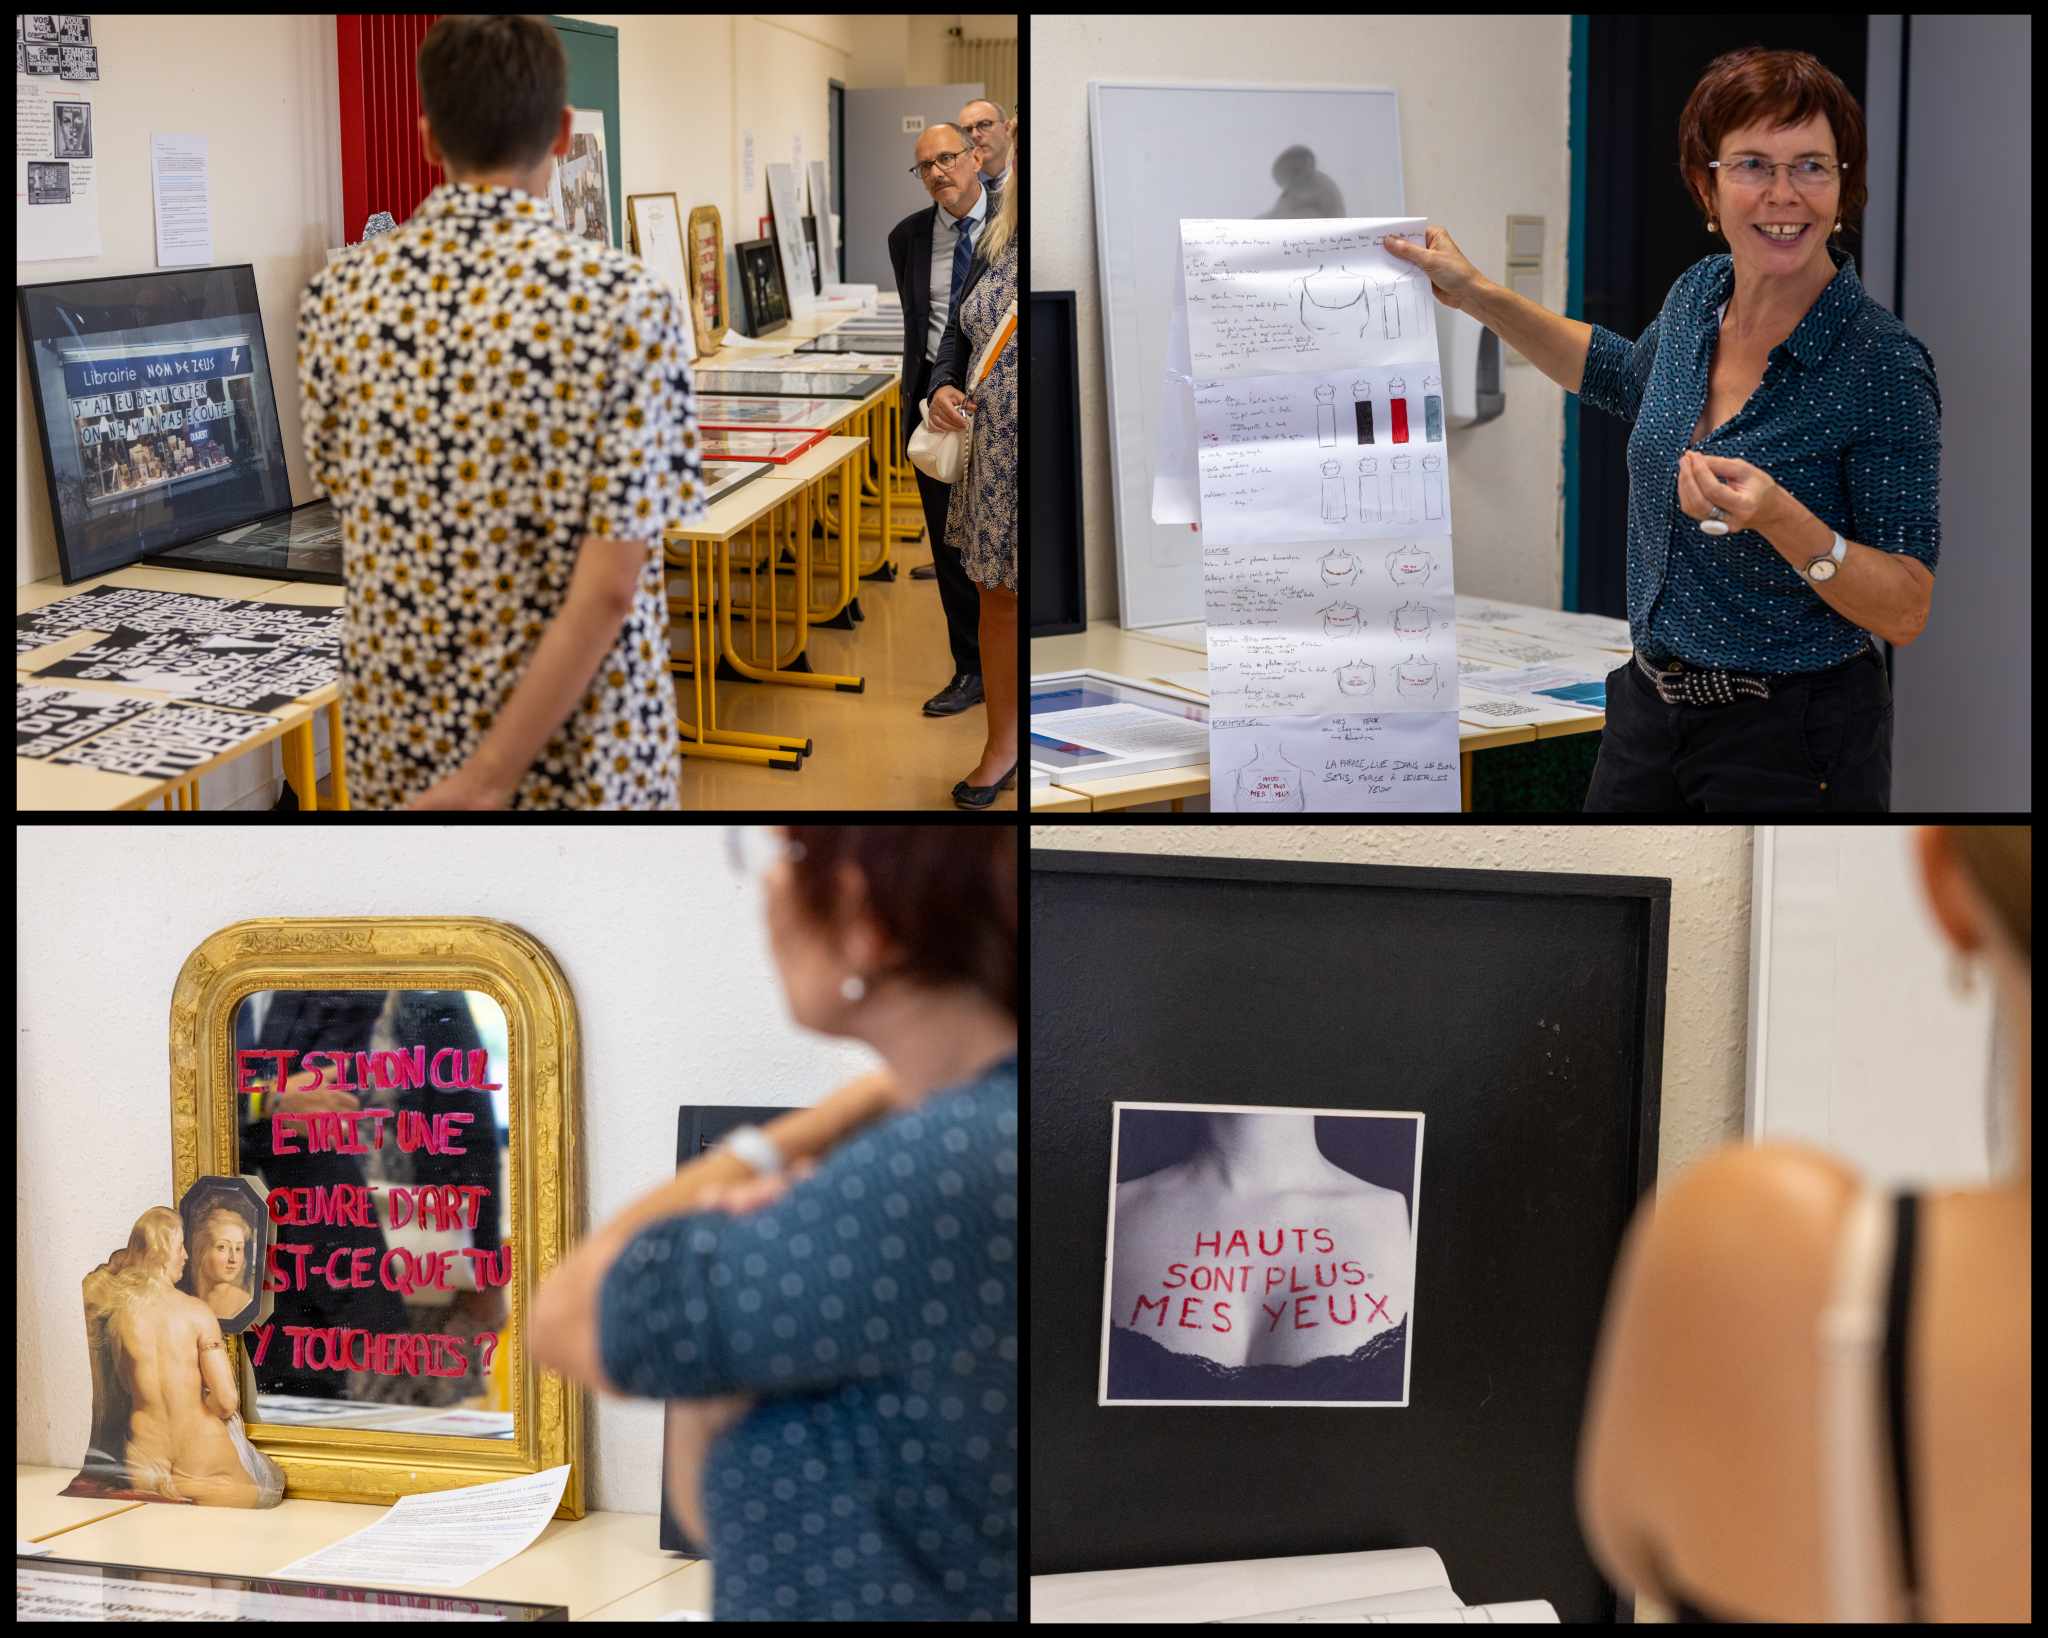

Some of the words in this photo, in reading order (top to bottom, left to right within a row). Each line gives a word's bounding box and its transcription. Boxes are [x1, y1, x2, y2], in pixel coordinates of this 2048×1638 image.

[83, 368, 137, 387] Librairie
[146, 363, 172, 380] NOM
[176, 362, 189, 375] DE
[191, 358, 216, 374] ZEUS
[118, 394, 134, 411] EU
[136, 388, 170, 407] BEAU
[172, 382, 208, 401] CRIER
[83, 426, 102, 445] ON
[110, 423, 124, 438] NE
[161, 412, 182, 430] PAS
[76, 632, 181, 678] SILENCE
[17, 706, 78, 734] DU
[17, 699, 154, 758] SILENCE
[237, 1049, 299, 1093] ET
[356, 1045, 426, 1091] MON
[429, 1047, 503, 1091] CUL
[271, 1108, 395, 1155] ETAIT
[397, 1110, 475, 1156] UNE
[389, 1184, 492, 1232] D'ART
[1194, 1227, 1336, 1258] HAUTS
[264, 1243, 377, 1292] ST-CE
[380, 1246, 456, 1296] QUE
[464, 1244, 513, 1292] TU
[1162, 1262, 1254, 1294] SONT
[1264, 1260, 1366, 1296] PLUS
[1130, 1294, 1232, 1333] MES
[1262, 1292, 1393, 1332] YEUX
[251, 1324, 275, 1367] Y
[282, 1325, 470, 1378] TOUCHERAIS
[474, 1330, 498, 1378] ?
